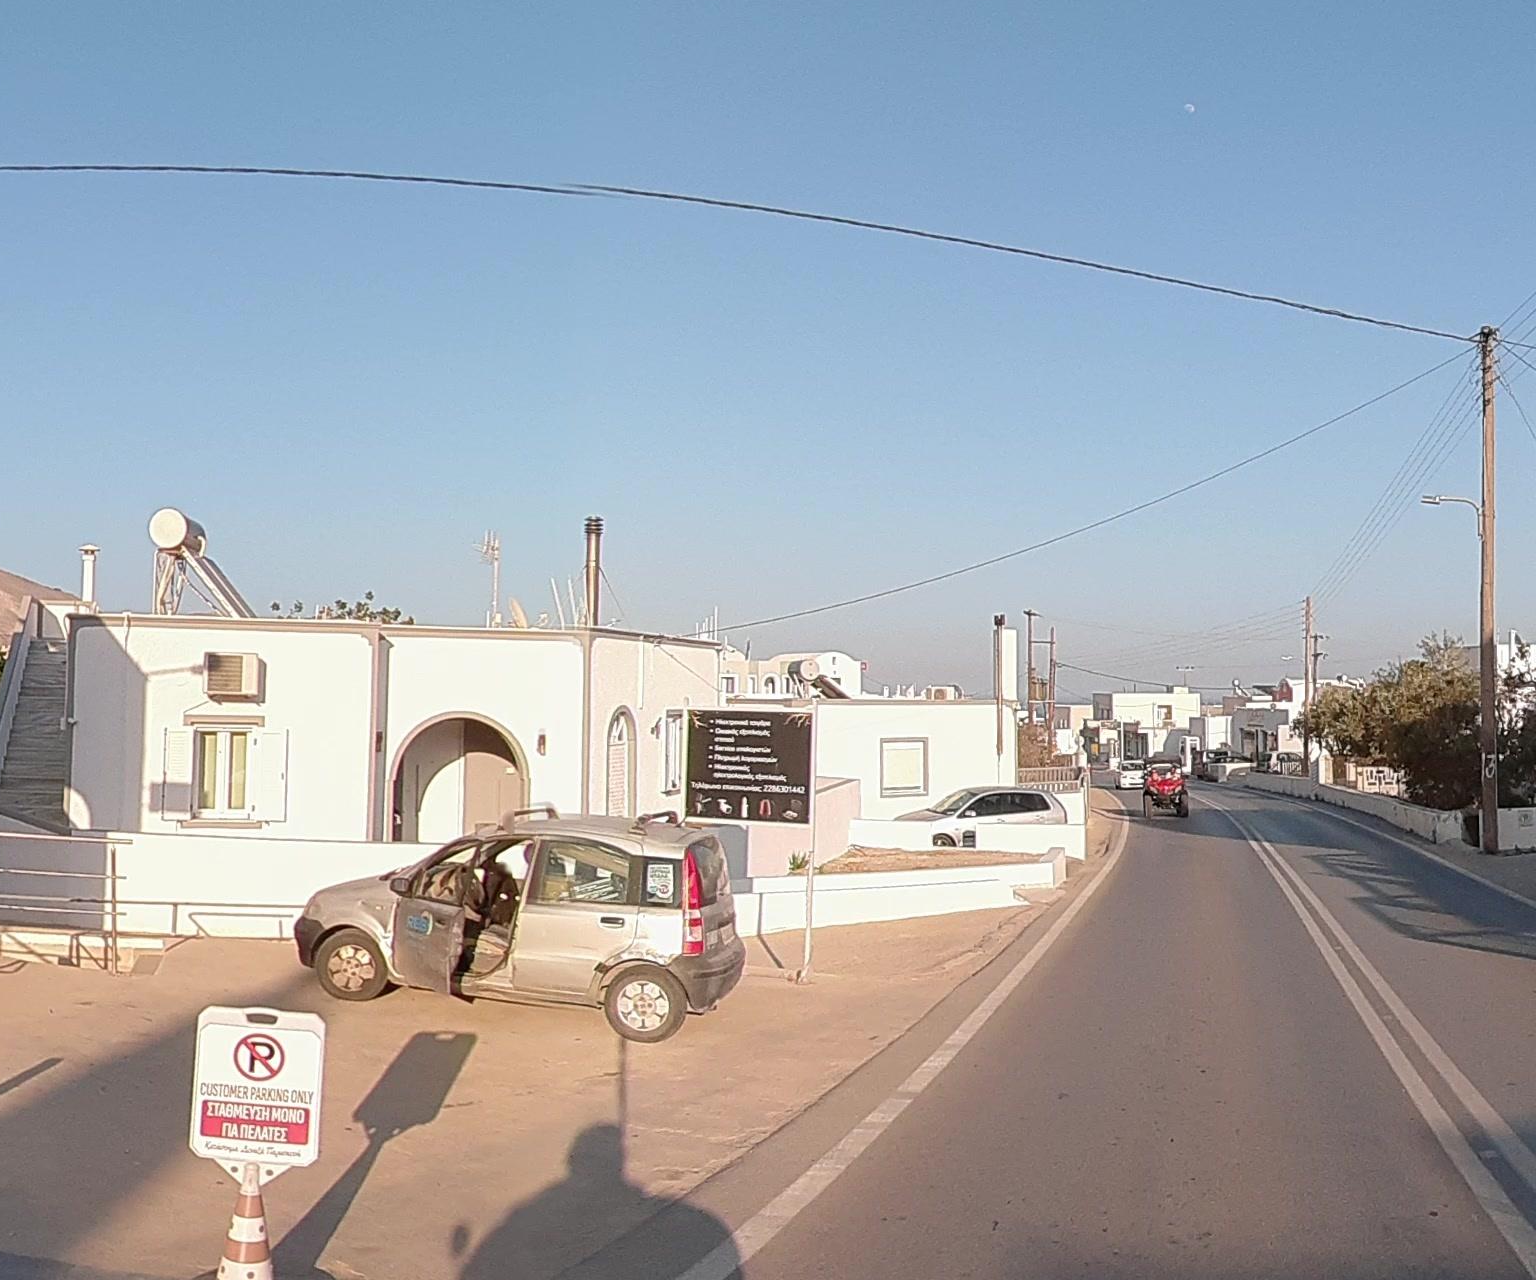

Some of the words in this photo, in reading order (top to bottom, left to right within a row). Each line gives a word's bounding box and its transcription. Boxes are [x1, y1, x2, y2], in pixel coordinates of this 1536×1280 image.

[200, 1082, 249, 1100] CUSTOMER
[250, 1086, 290, 1103] PARKING
[290, 1089, 314, 1105] ONLY
[206, 1102, 270, 1123] ΣΤΑΘΜΕΥΣΗ
[271, 1108, 305, 1124] ΜΟΝΟ
[221, 1122, 239, 1138] ΓΙΑ
[239, 1124, 288, 1143] ΠΕΛΑΤΕΣ
